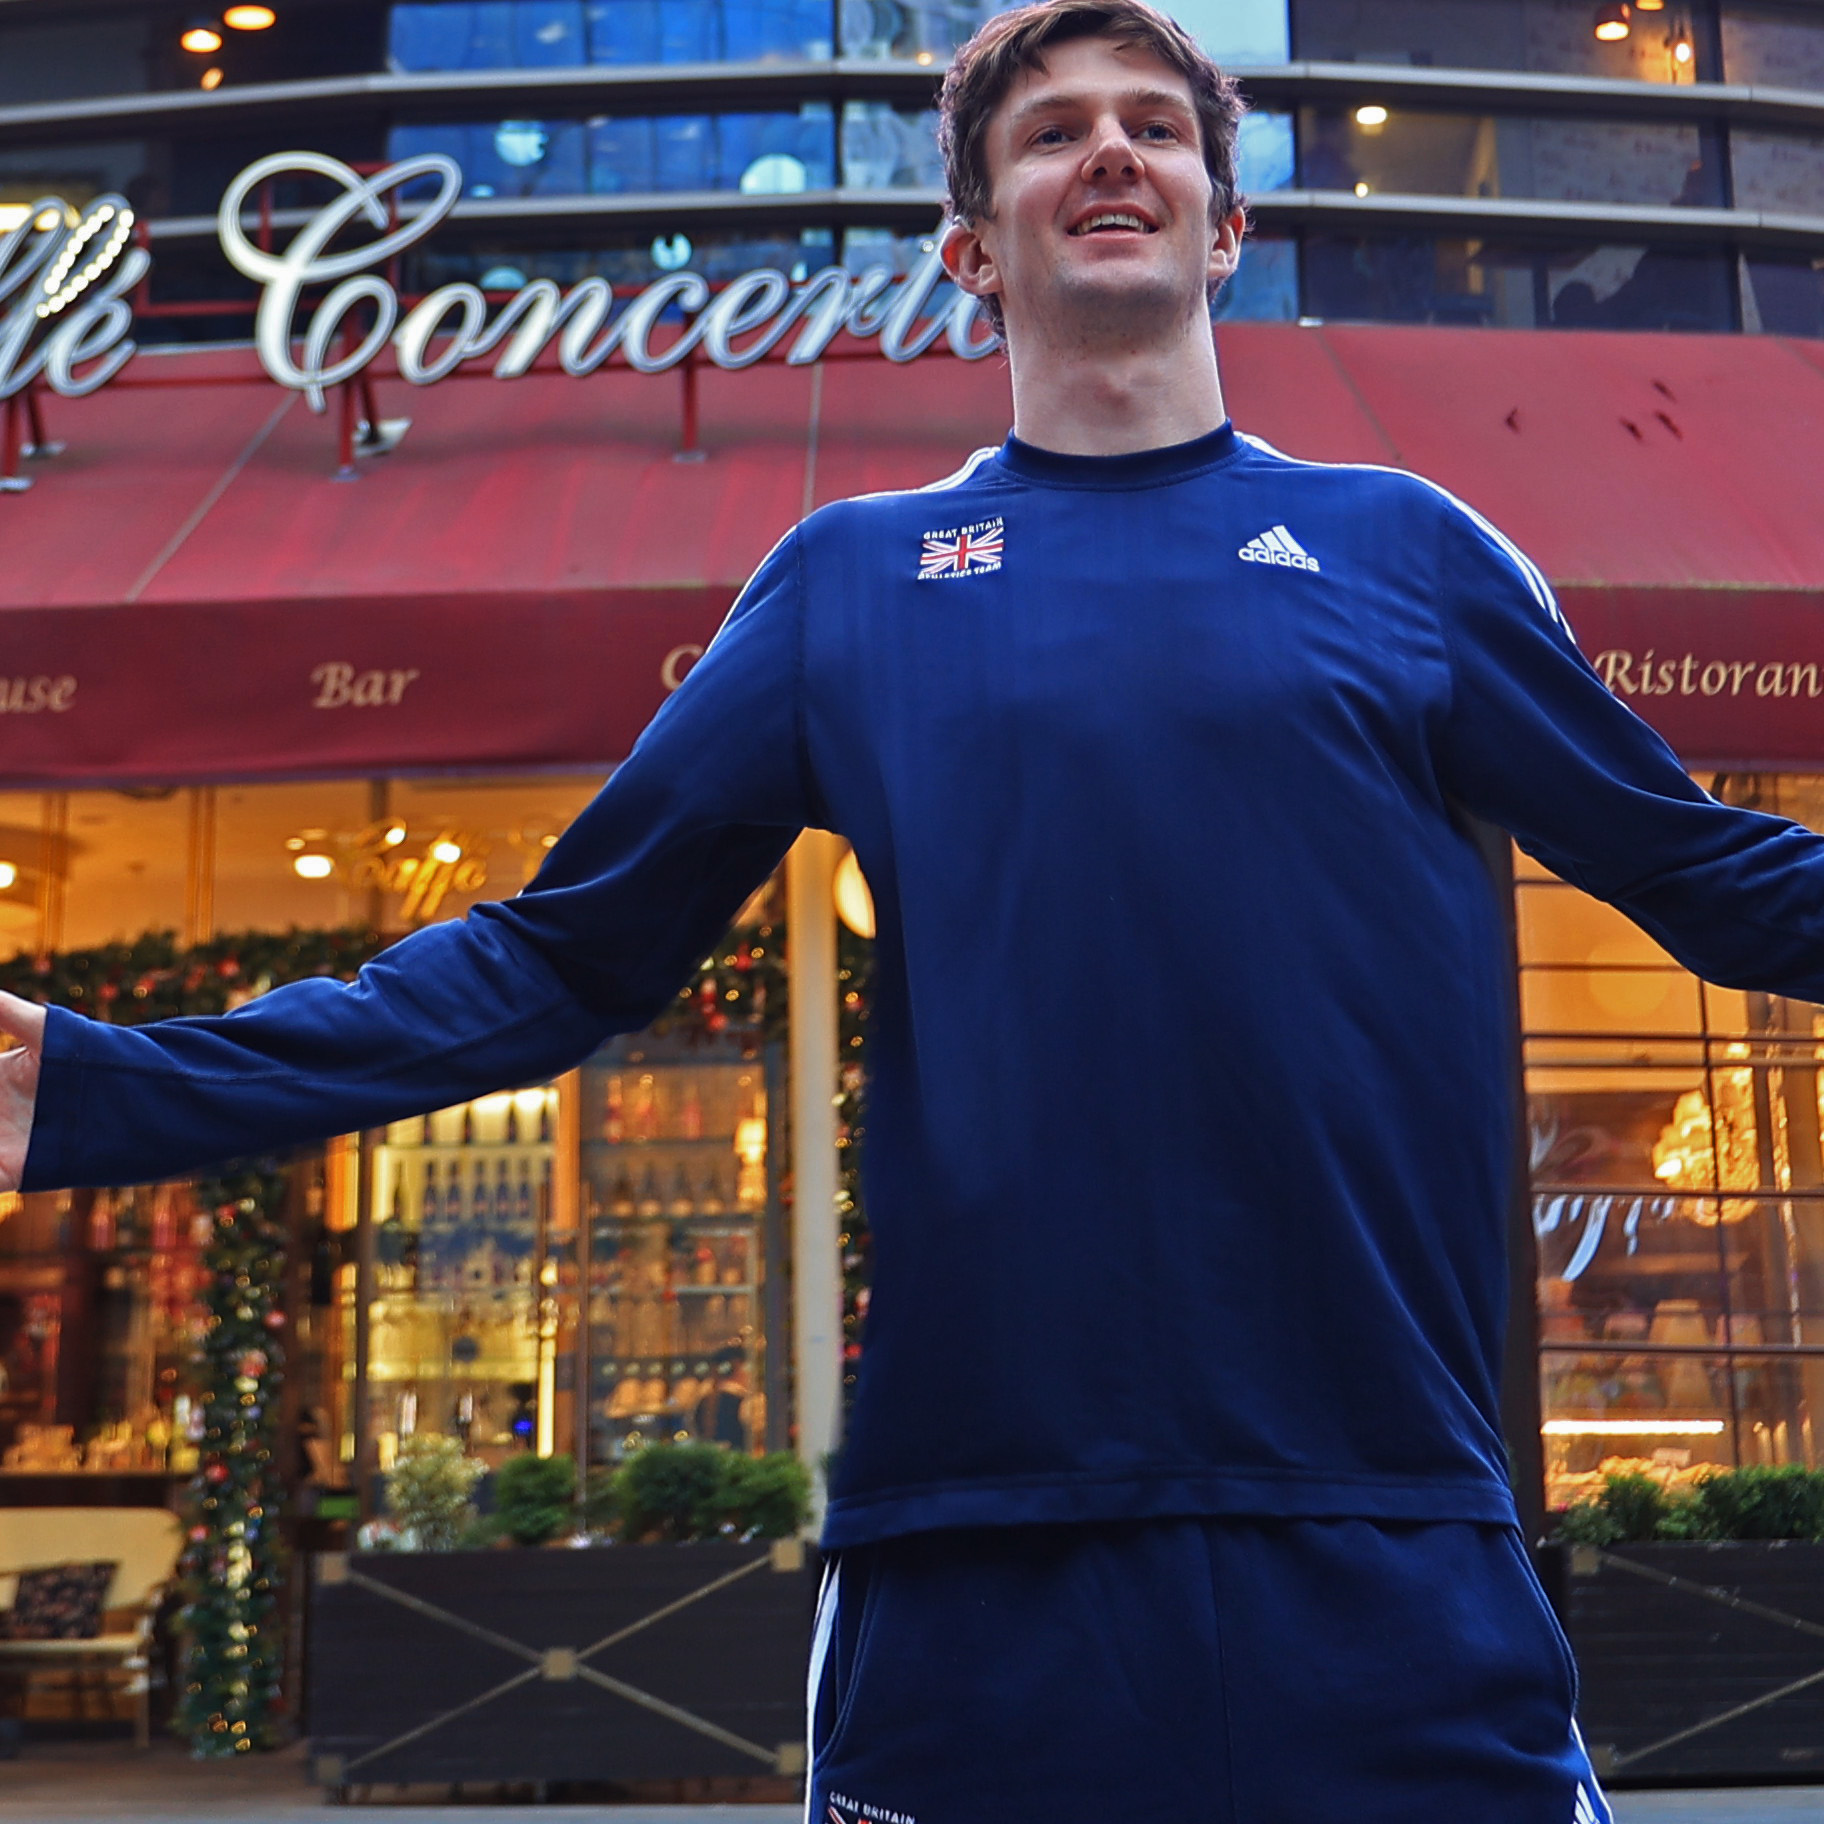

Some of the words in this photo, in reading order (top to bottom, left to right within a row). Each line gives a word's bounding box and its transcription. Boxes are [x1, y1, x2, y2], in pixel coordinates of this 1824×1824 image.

[923, 529, 958, 540] GREAT
[961, 516, 1004, 535] BRITAIN
[1238, 546, 1321, 573] adidas
[310, 661, 421, 709] Bar
